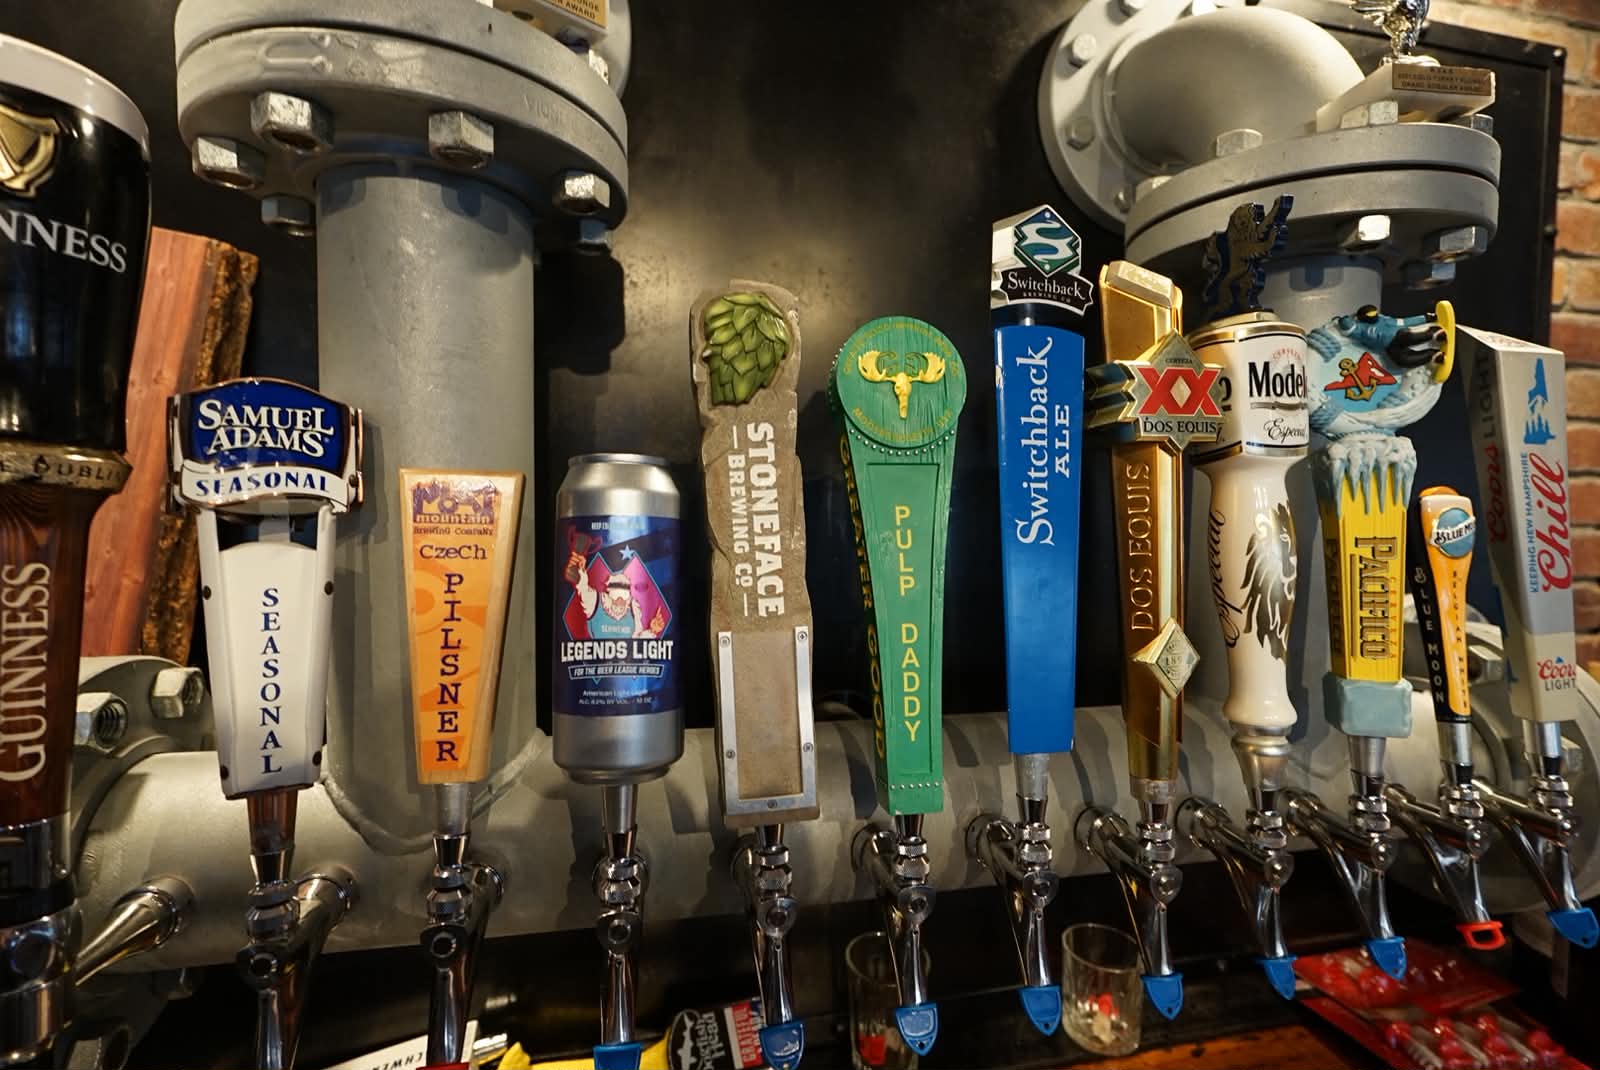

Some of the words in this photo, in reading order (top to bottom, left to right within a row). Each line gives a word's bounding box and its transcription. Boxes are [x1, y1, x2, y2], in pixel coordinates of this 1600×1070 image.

[1008, 271, 1086, 301] Switchback
[1136, 367, 1222, 417] XX
[1248, 361, 1308, 399] Model
[197, 399, 334, 436] SAMUEL
[206, 426, 325, 458] ADAMS
[1015, 336, 1055, 546] Switchback
[1054, 404, 1070, 479] ALE
[1143, 420, 1174, 433] DOS
[1177, 420, 1217, 433] EQUIS
[195, 471, 329, 497] SEASONAL
[727, 453, 751, 554] BREWING
[1126, 463, 1152, 557] EQUIS
[1520, 452, 1534, 518] HAMPSHIRE
[746, 421, 785, 618] STONEFACE
[895, 505, 915, 596] PULP
[1526, 521, 1536, 543] NEW
[1529, 453, 1573, 593] Chill
[1130, 567, 1154, 631] DOS
[1354, 536, 1398, 661] PACIFICO
[1528, 547, 1539, 594] KEEPING
[436, 573, 465, 762] PILSNER
[561, 641, 628, 663] LEGENDS
[633, 640, 674, 660] LIGHT
[1414, 567, 1434, 631] BLUE
[1427, 643, 1445, 703] MOON
[0, 561, 51, 783] GUINNESS
[259, 587, 283, 775] SEASONAL
[574, 668, 584, 677] FOR
[585, 666, 595, 676] THE
[597, 666, 613, 675] BEER
[614, 665, 638, 675] LEAGUE
[901, 623, 921, 742] DADDY
[1544, 678, 1576, 691] LIGHT
[733, 1007, 757, 1063] GRATEFUL
